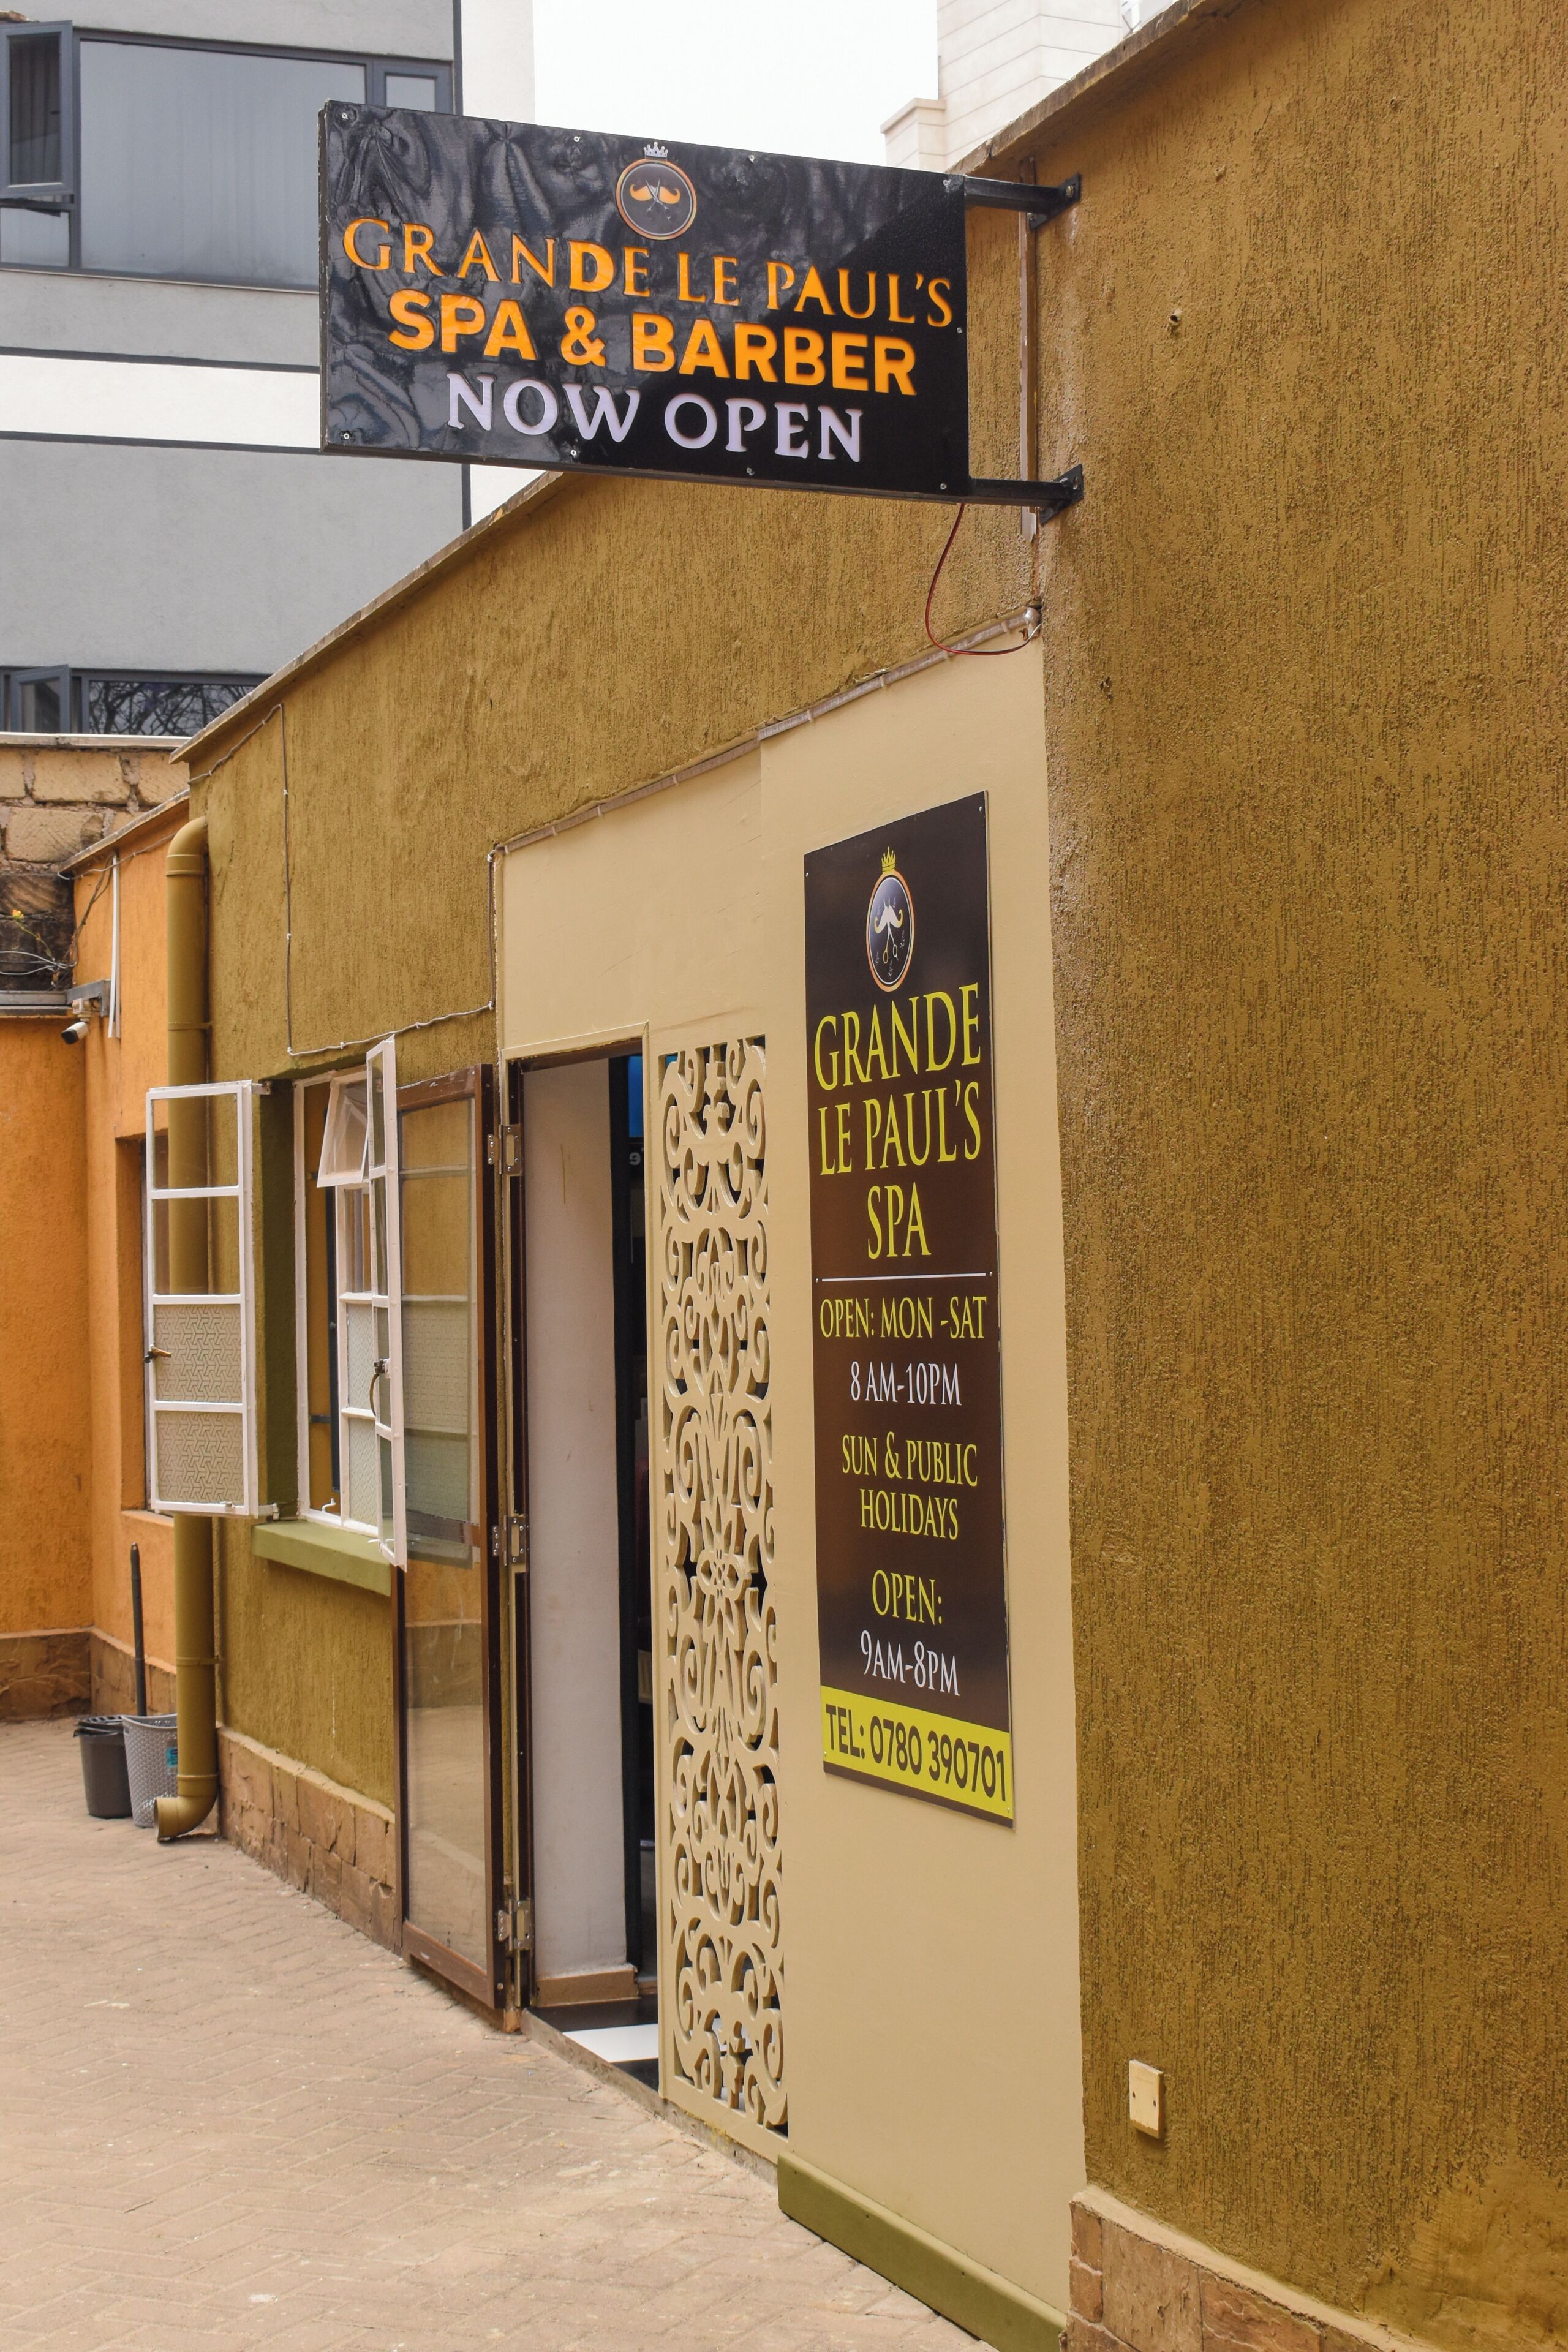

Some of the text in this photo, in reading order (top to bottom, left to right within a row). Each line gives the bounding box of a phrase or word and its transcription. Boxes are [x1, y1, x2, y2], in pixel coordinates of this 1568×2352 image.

[344, 217, 953, 328] GRANDE LE PAUL'S
[388, 288, 918, 396] SPA & BARBER
[447, 372, 863, 462] NOW OPEN
[814, 982, 981, 1091] GRANDE
[818, 1079, 981, 1175] LE PAUL'S
[867, 1181, 932, 1260] SPA
[820, 1297, 875, 1338] OPEN:
[880, 1297, 933, 1339] MON
[842, 1431, 978, 1487] SUN & PUBLIC
[859, 1488, 959, 1541] HOLIDAYS
[872, 1569, 943, 1626] OPEN:
[860, 1629, 960, 1697] 9AM-8PM
[825, 1703, 1006, 1802] TEL: 0780 390701
